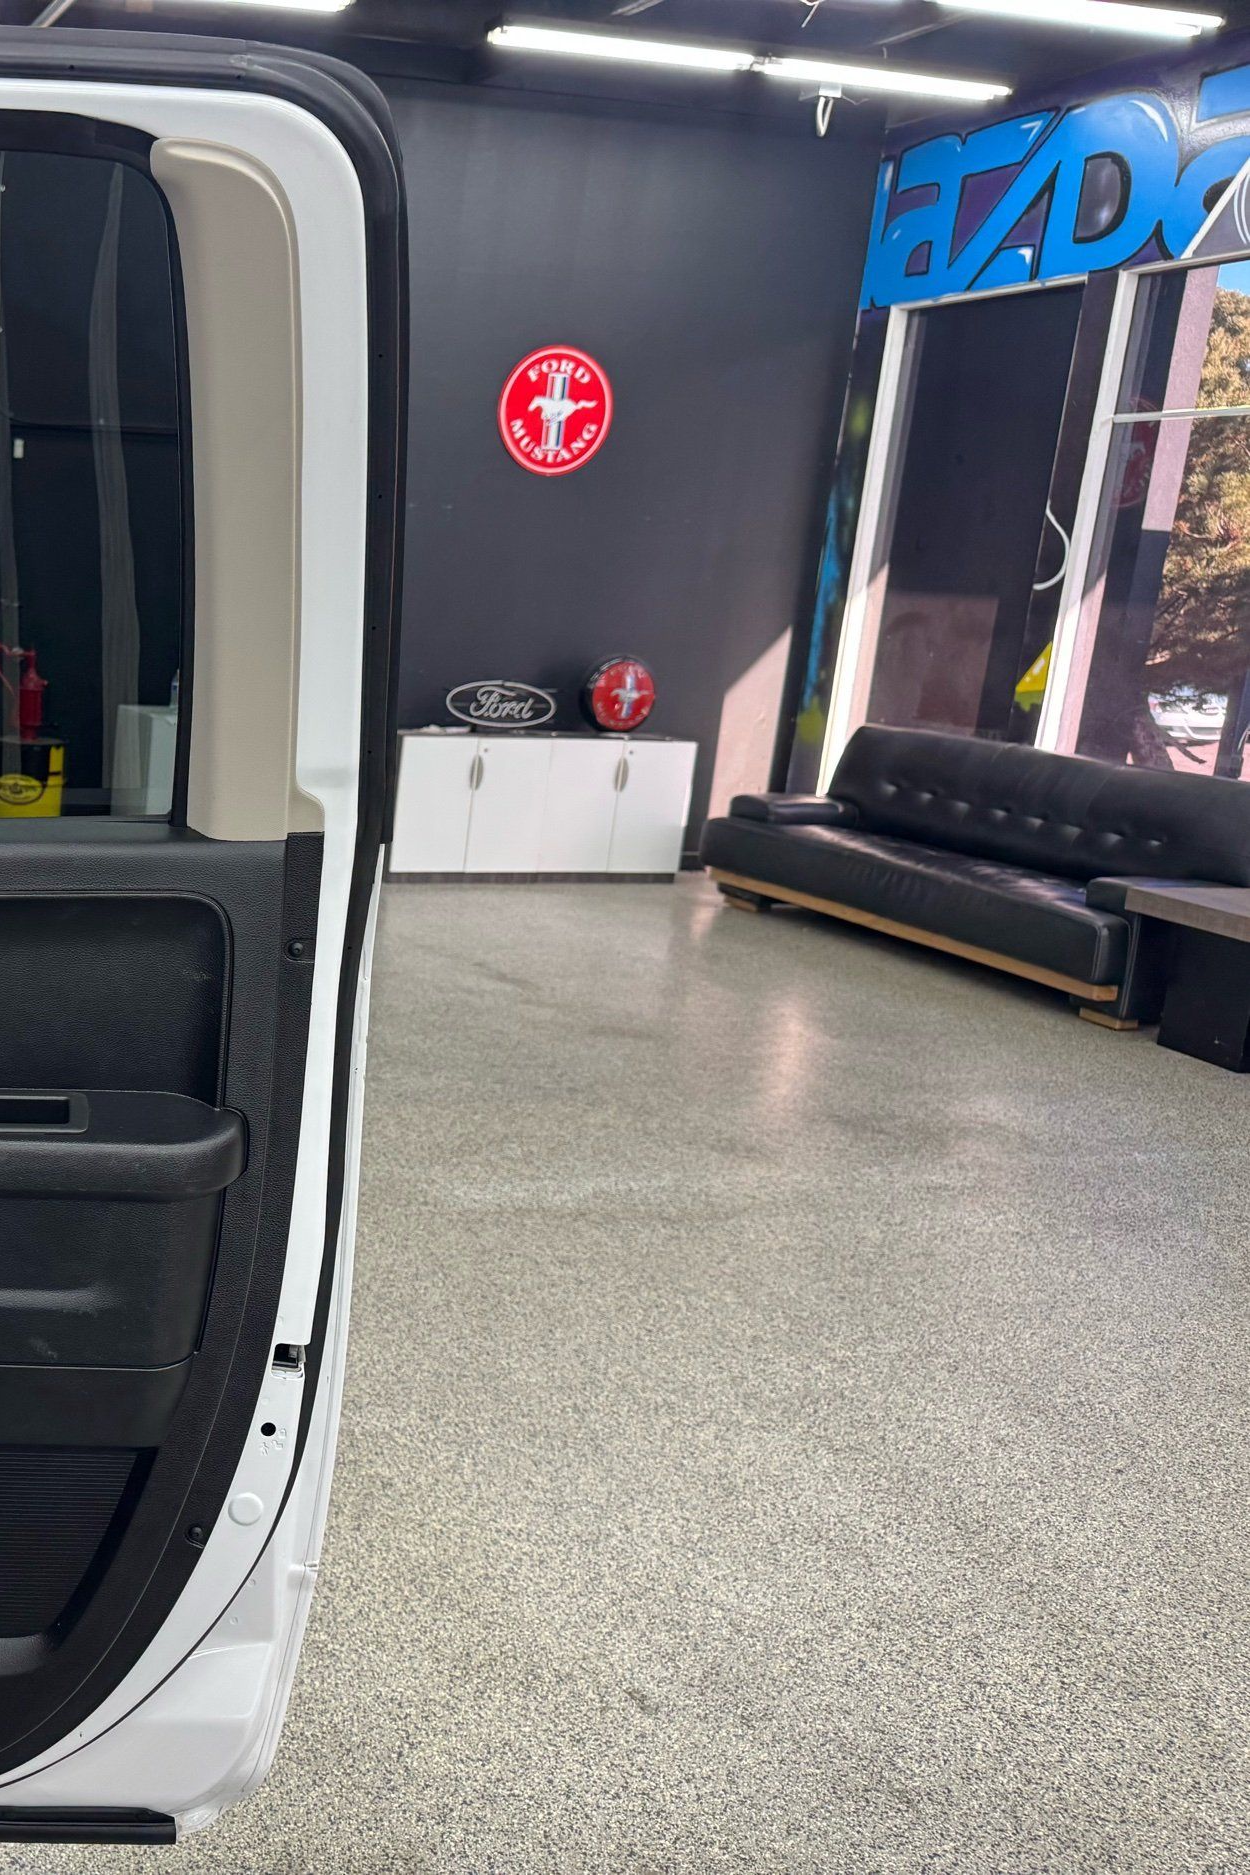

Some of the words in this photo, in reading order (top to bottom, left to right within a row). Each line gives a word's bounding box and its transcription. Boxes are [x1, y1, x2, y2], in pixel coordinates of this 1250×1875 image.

[527, 360, 590, 383] FORD
[510, 419, 598, 463] MUSTANG
[469, 686, 534, 719] Ford
